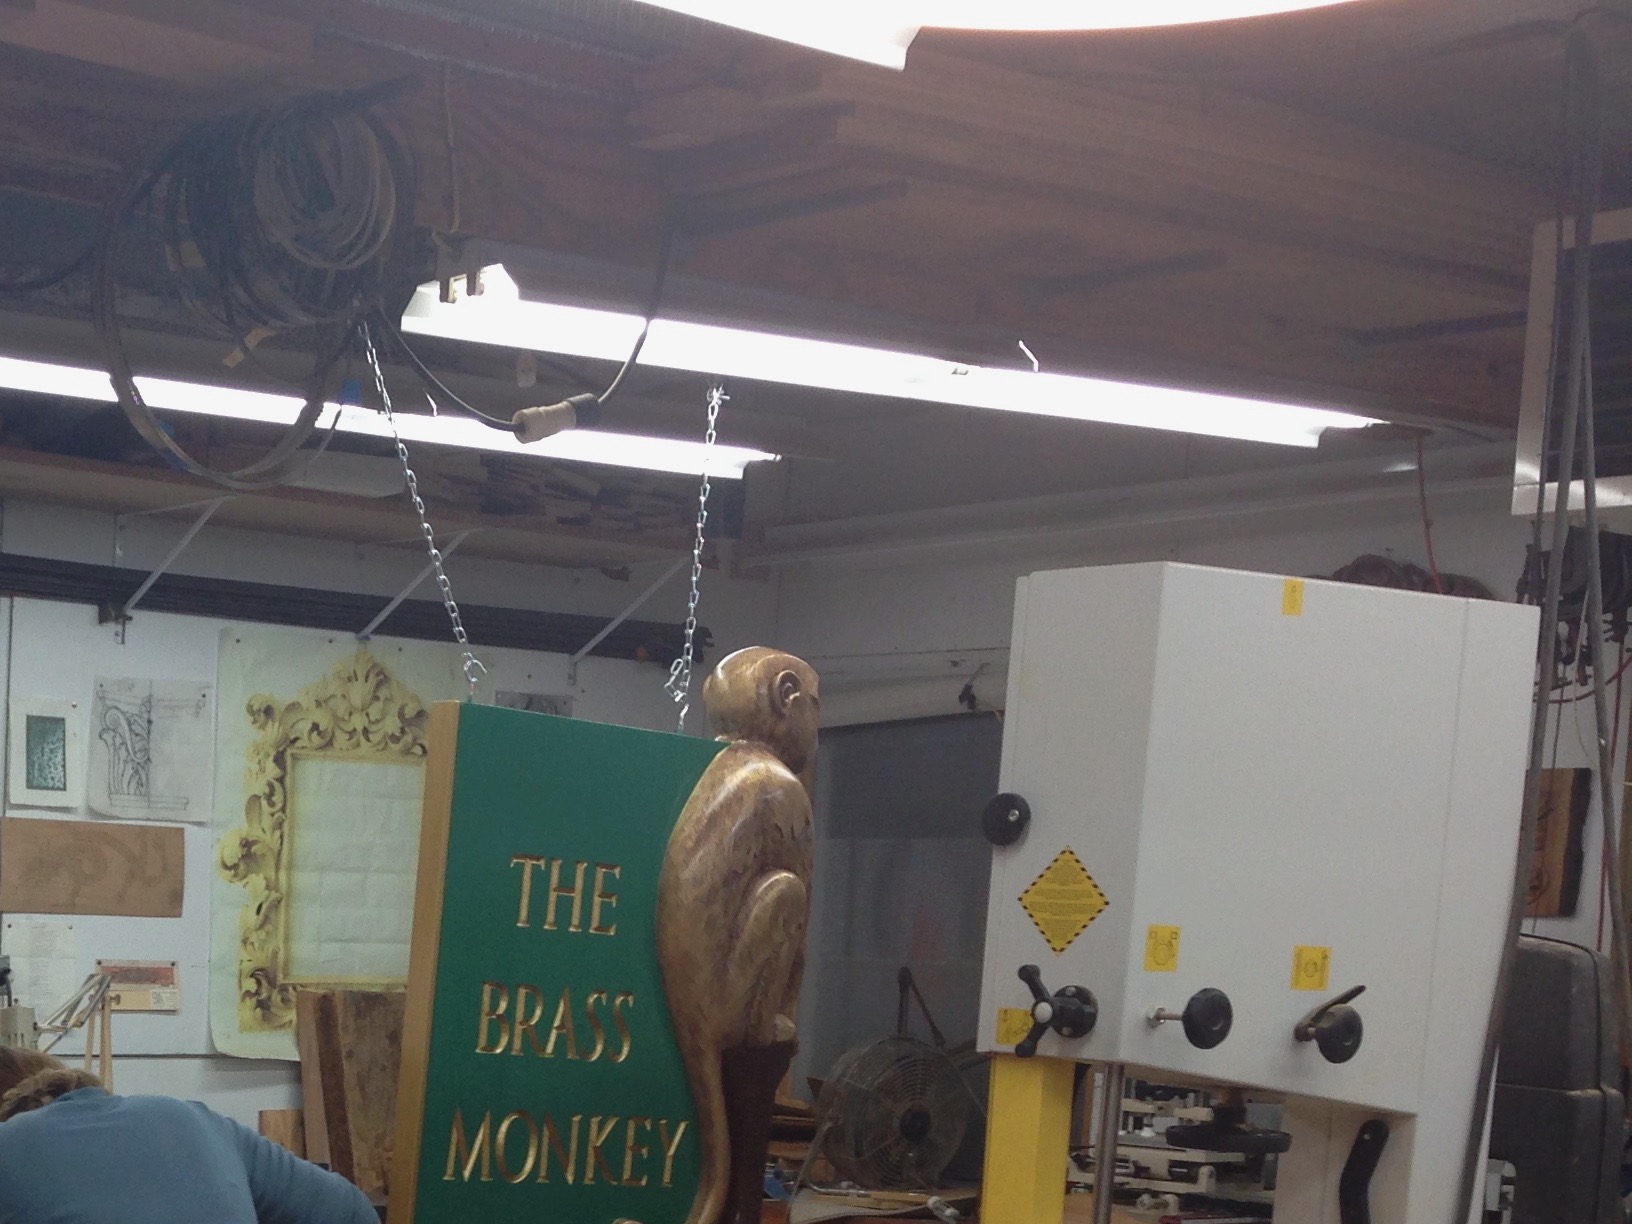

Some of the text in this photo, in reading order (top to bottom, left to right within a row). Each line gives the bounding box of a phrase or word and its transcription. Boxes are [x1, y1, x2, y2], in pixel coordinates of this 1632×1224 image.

[509, 853, 622, 936] THE
[475, 979, 635, 1064] BRASS
[442, 1106, 690, 1188] MONKEY
